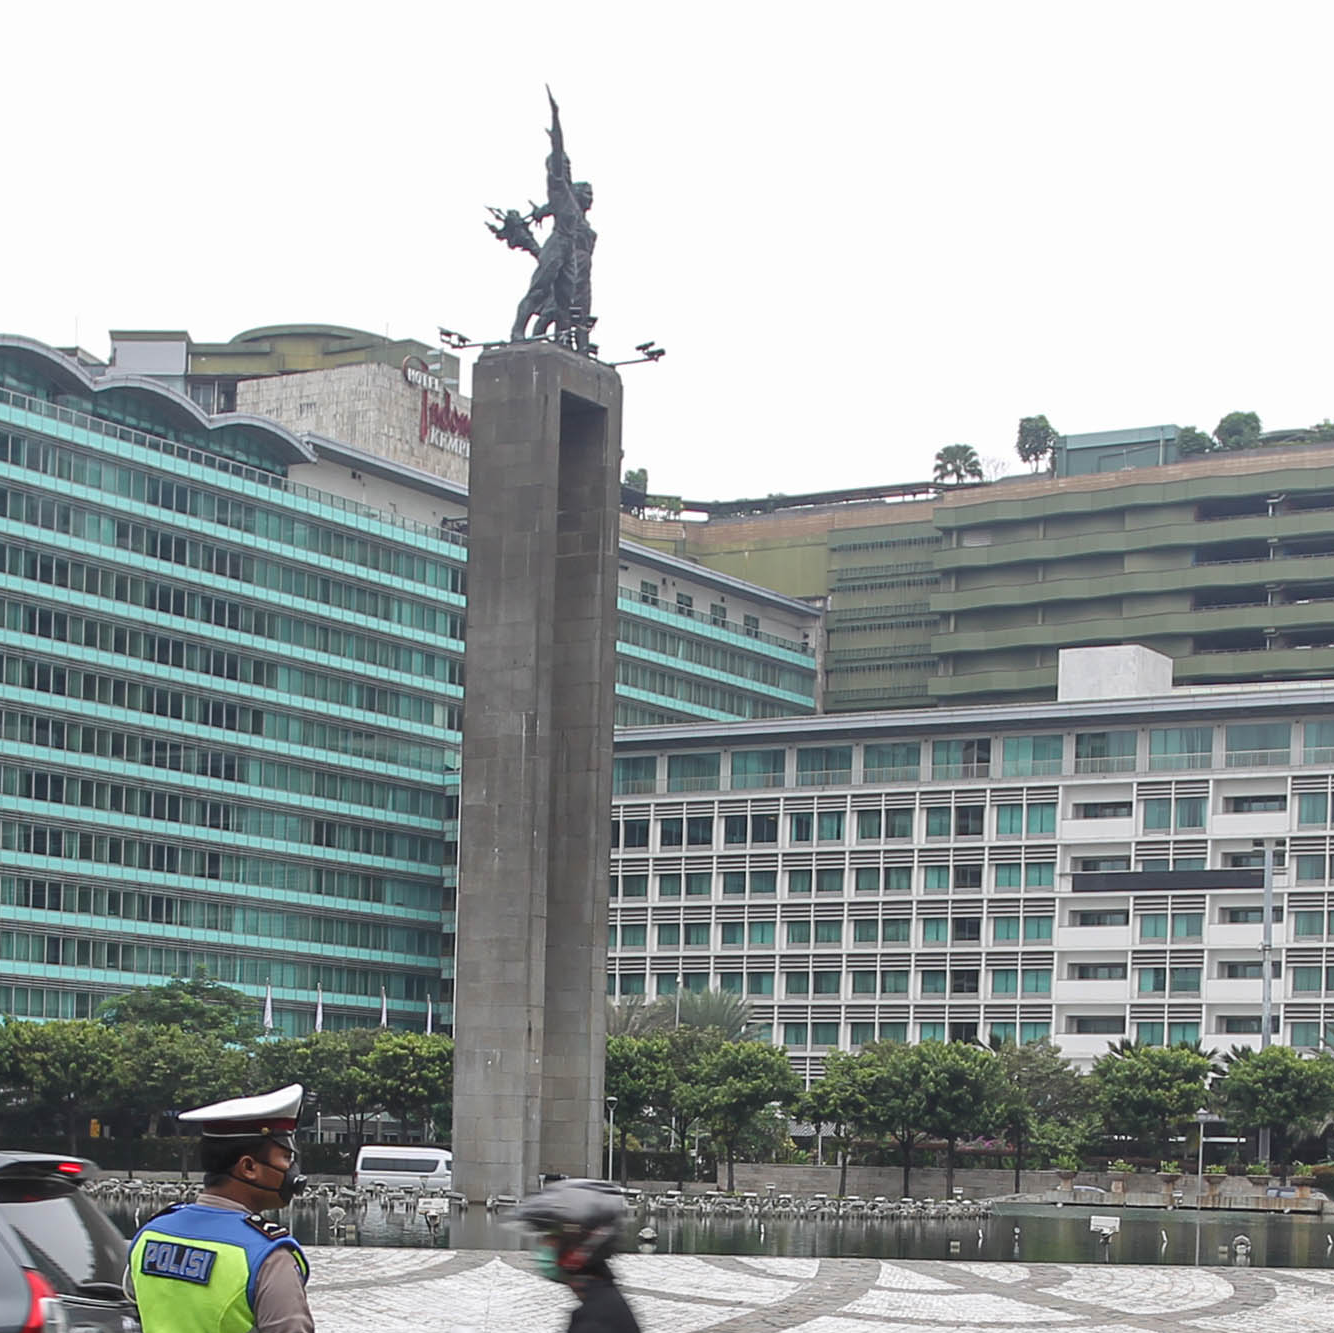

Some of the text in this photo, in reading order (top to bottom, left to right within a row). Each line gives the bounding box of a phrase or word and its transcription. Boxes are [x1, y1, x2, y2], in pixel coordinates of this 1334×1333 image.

[408, 368, 439, 391] HOTEL
[430, 426, 470, 457] KEMPI
[143, 1242, 212, 1280] POLISI
